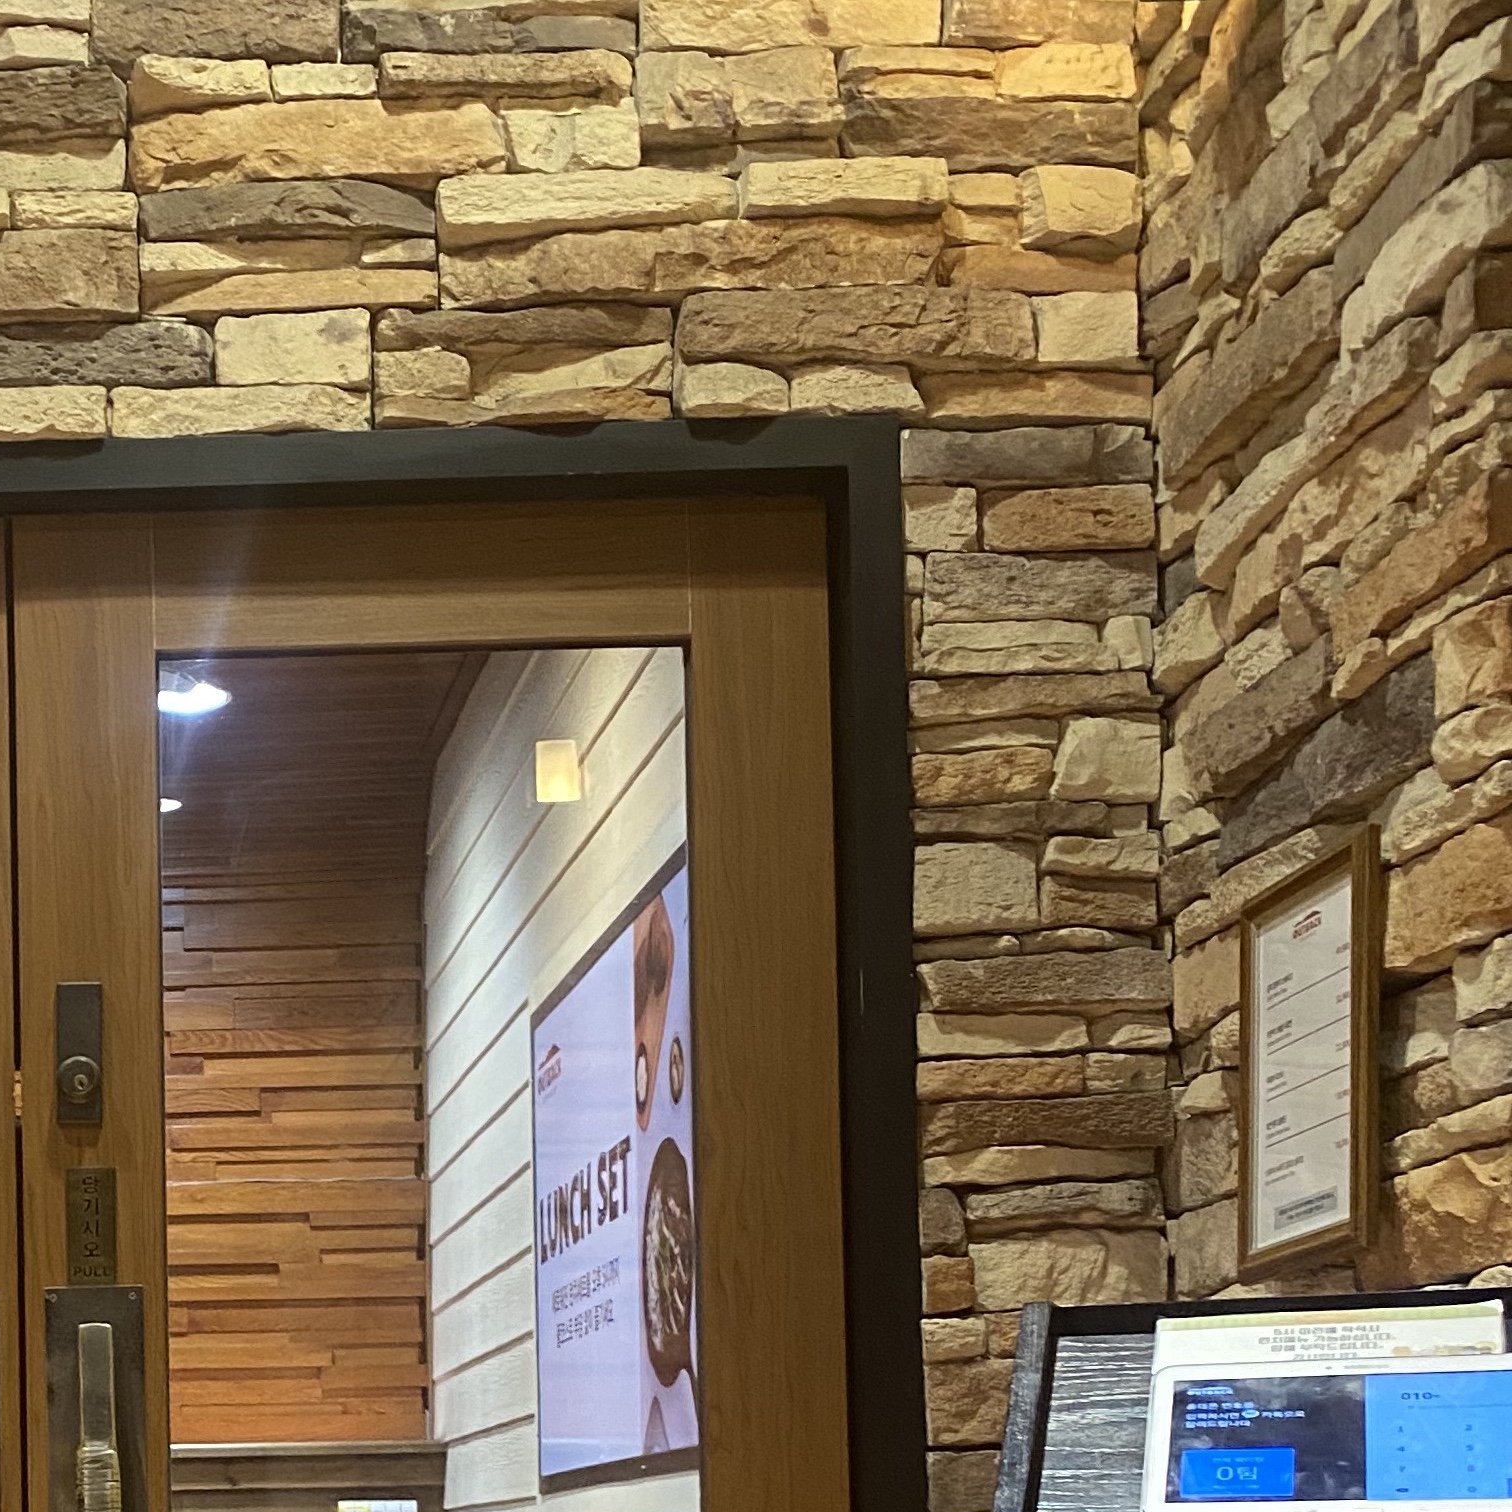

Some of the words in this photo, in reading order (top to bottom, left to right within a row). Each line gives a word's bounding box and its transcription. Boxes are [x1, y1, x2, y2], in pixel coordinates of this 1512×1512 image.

[81, 1174, 100, 1258] 당기시오
[540, 1161, 591, 1265] LUNCH
[597, 1134, 632, 1226] SET
[74, 1265, 111, 1278] PULL
[1215, 1465, 1258, 1481] 0팀
